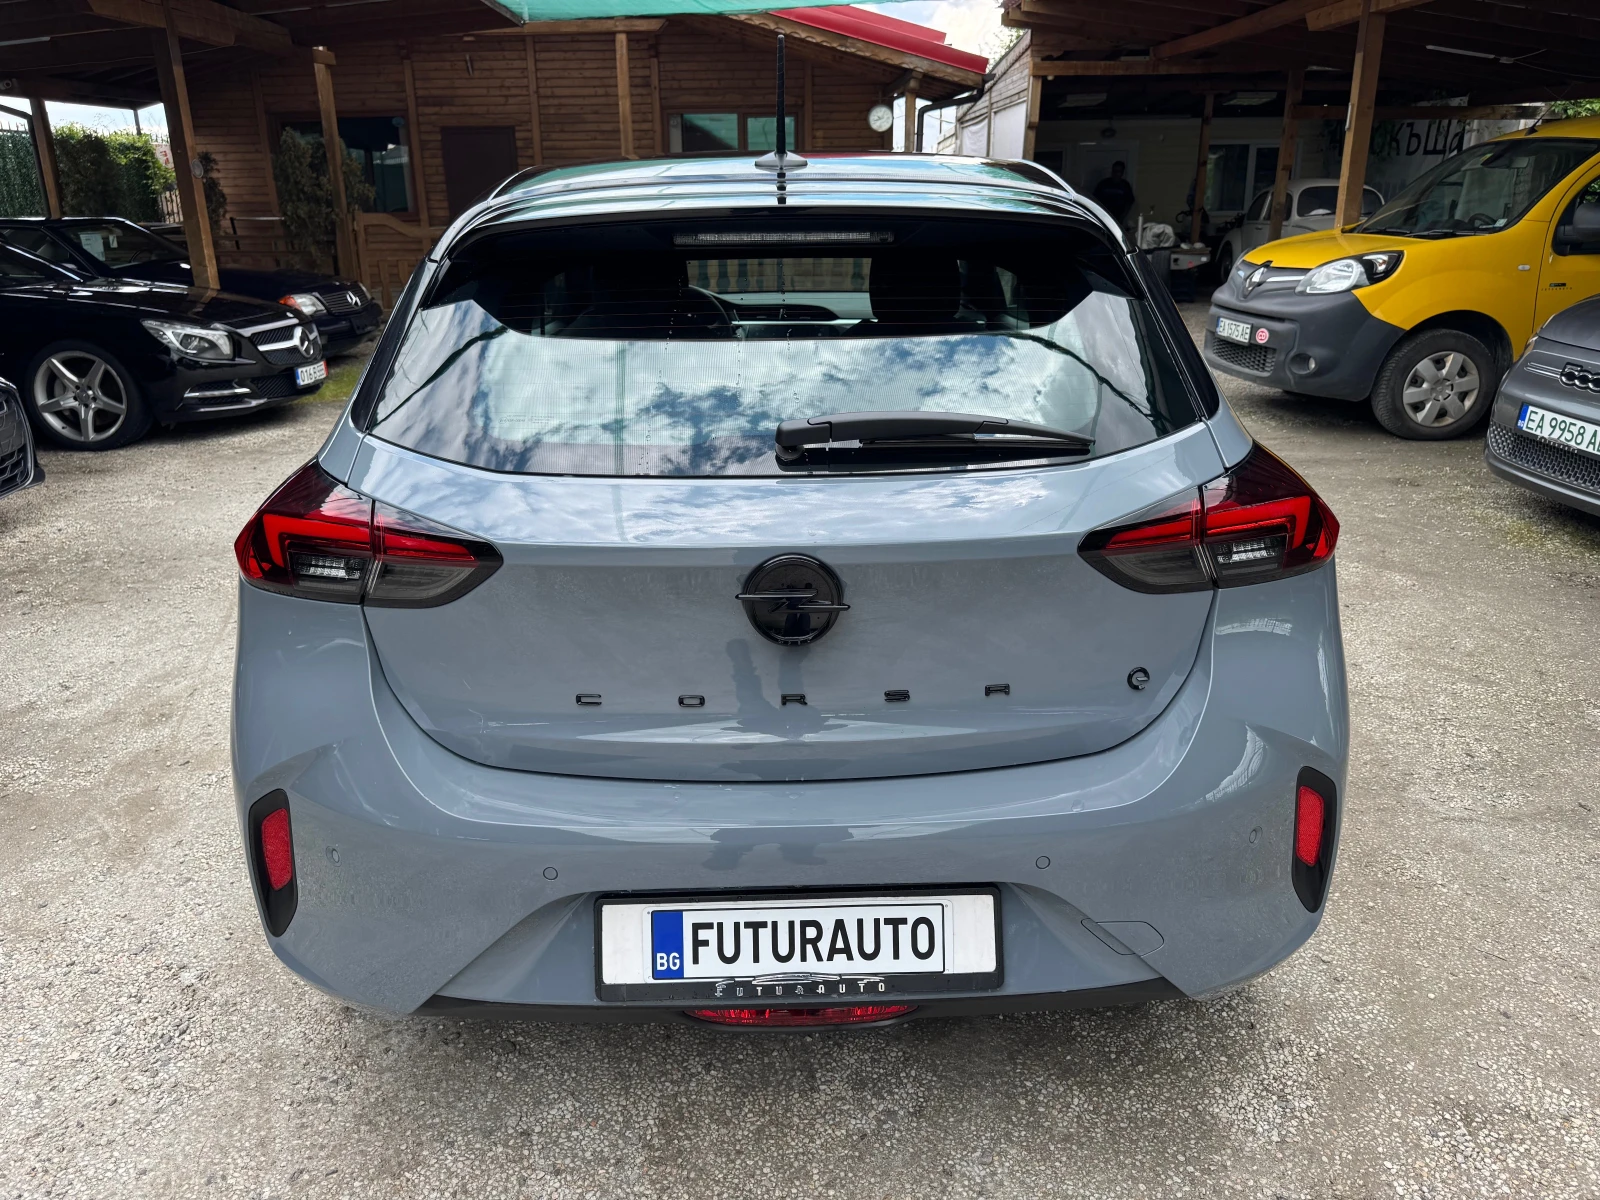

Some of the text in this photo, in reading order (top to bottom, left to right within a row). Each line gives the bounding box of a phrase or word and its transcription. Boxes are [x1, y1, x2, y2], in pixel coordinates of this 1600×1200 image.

[1525, 410, 1545, 434] EA
[1548, 417, 1586, 446] 9958
[1586, 429, 1600, 455] A
[575, 683, 1011, 707] CORSA
[691, 916, 936, 965] FUTURAUTO
[656, 952, 680, 971] BG
